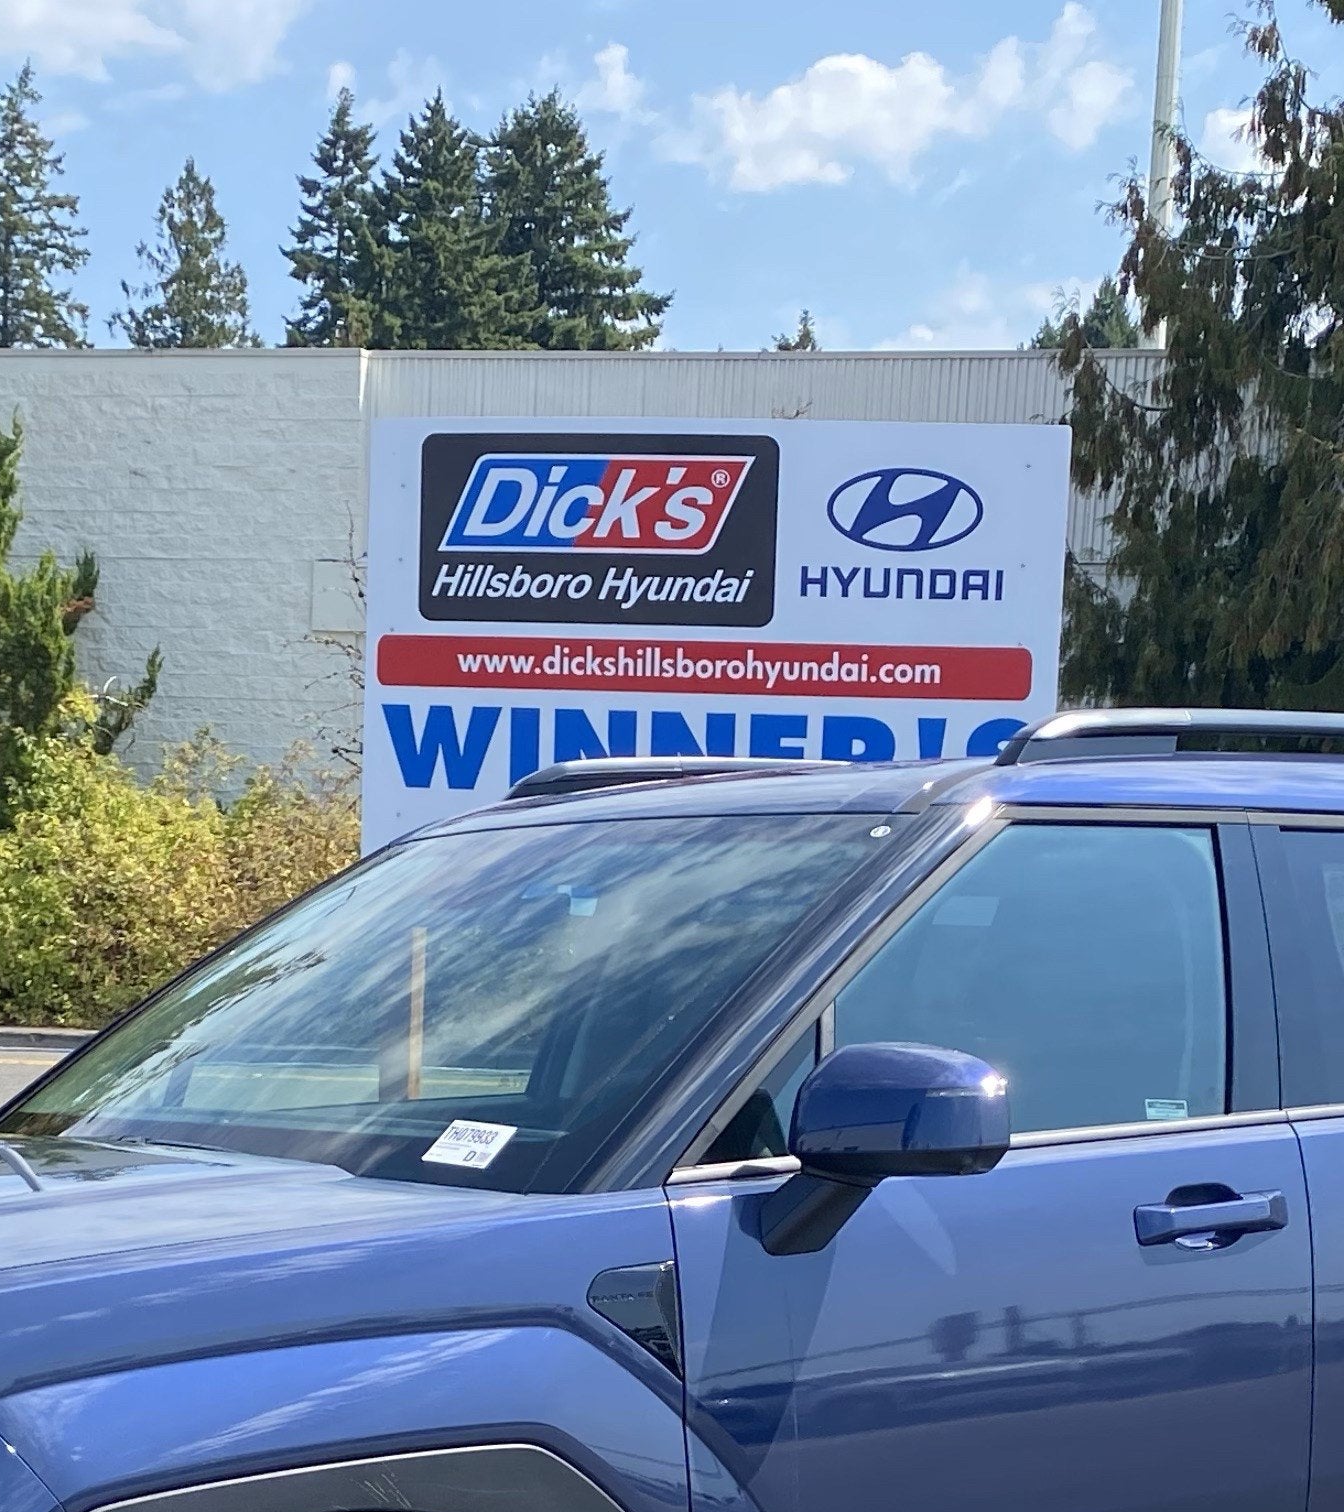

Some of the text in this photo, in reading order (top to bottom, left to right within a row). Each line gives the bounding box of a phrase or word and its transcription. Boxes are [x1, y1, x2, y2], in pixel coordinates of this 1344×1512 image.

[464, 465, 713, 541] Dick's
[431, 564, 755, 610] Hillsboro Hyundai
[800, 565, 1004, 601] HYUNDAI
[457, 645, 942, 695] www.dickshillsborohyundai.com
